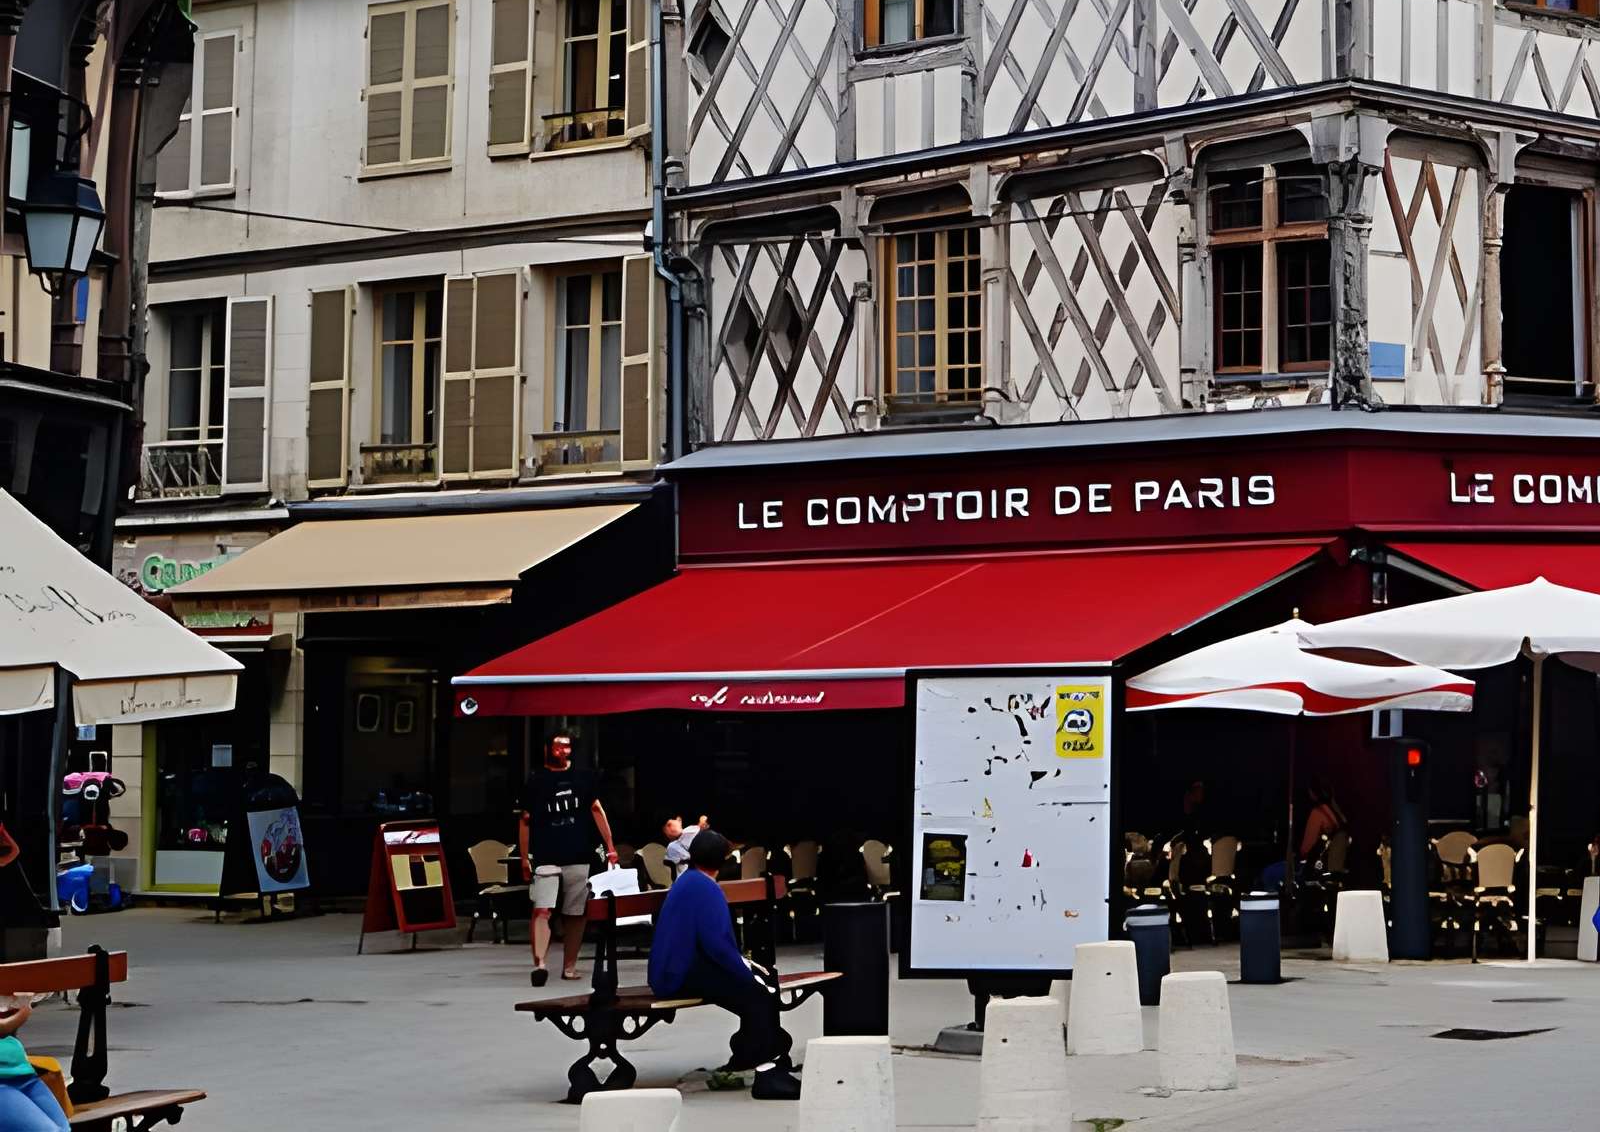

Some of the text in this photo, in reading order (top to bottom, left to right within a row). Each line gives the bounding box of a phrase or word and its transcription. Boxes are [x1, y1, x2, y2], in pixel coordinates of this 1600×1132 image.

[737, 475, 1276, 530] LE COMPTOIR DE PARIS
[1450, 472, 1495, 504] LE
